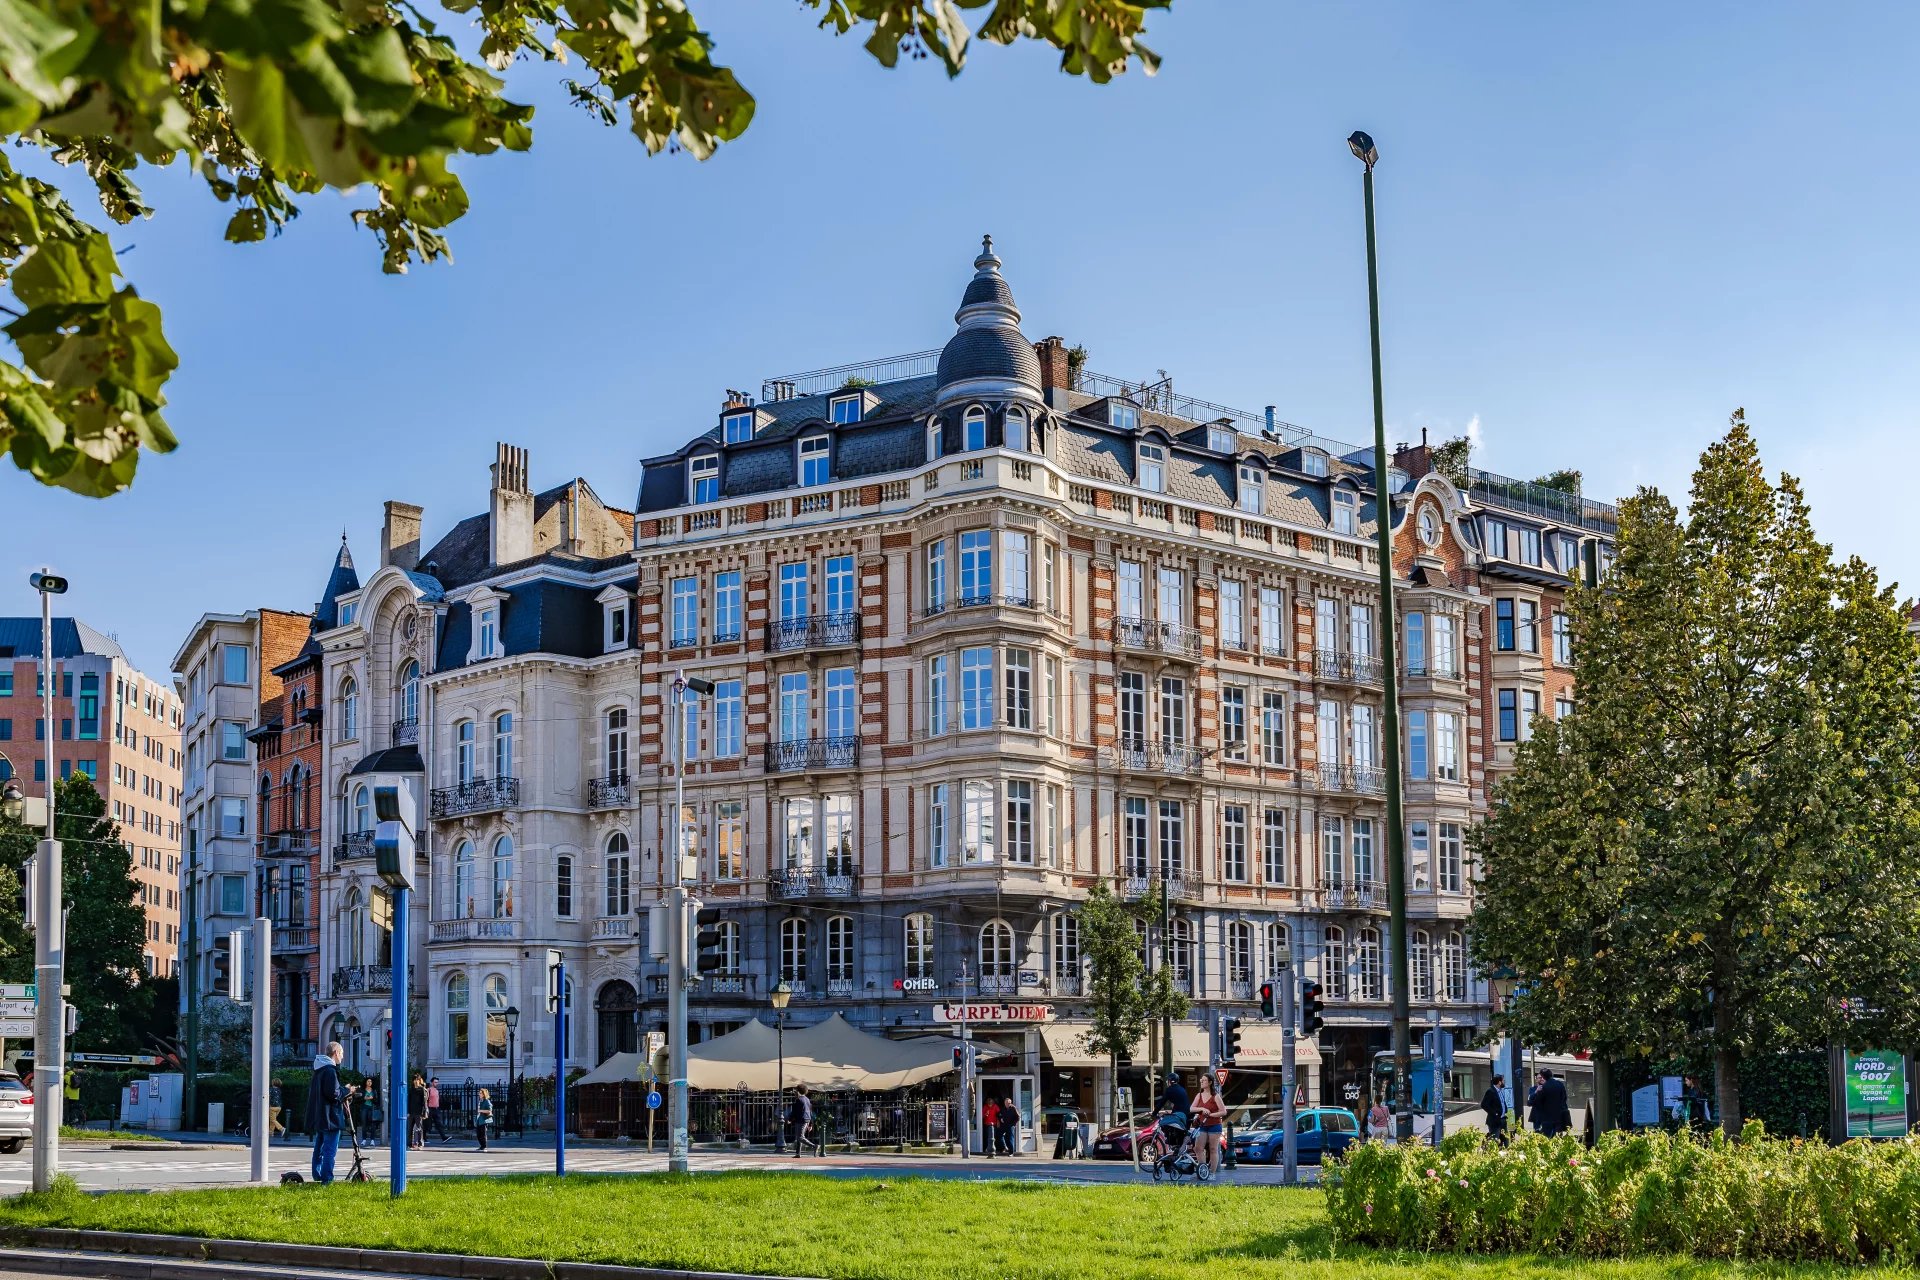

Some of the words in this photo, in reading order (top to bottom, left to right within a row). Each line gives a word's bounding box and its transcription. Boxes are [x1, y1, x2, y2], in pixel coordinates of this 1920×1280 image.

[903, 979, 939, 990] OMER.
[945, 1006, 1001, 1020] CARPE
[1007, 1006, 1046, 1019] DIEM
[1854, 1062, 1885, 1071] NORD
[1860, 1071, 1891, 1082] 6007
